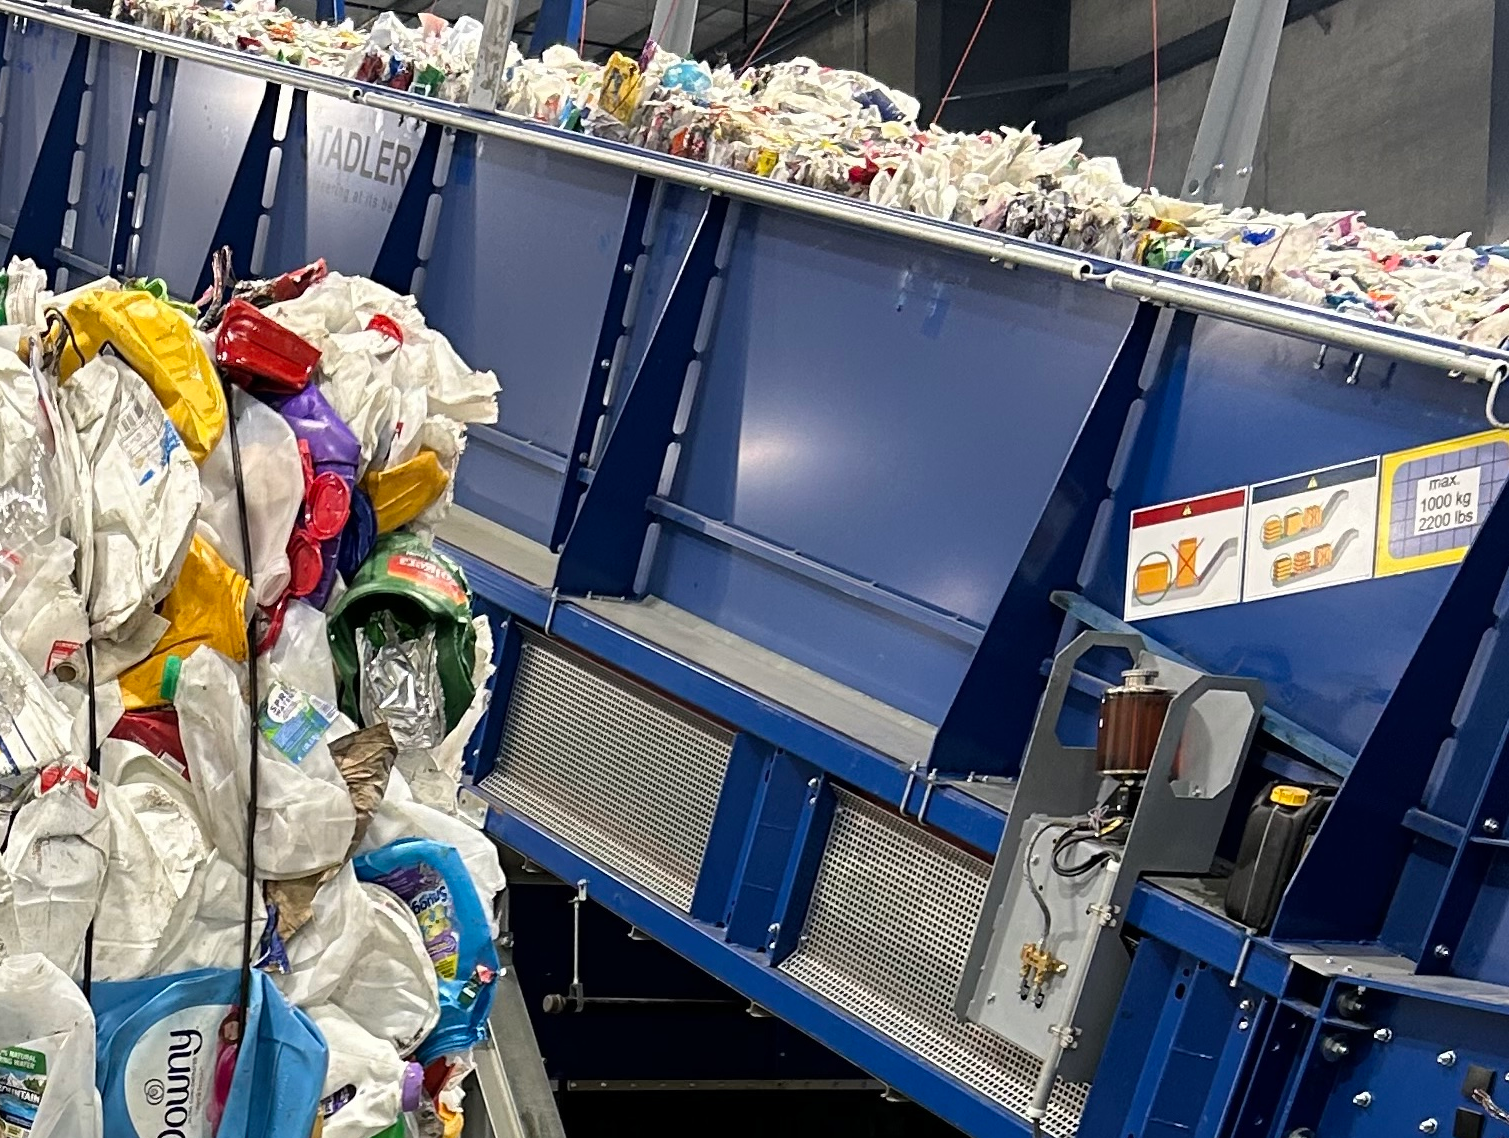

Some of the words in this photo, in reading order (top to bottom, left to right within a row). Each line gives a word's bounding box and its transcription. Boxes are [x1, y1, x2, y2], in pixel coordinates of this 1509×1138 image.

[1428, 474, 1460, 491] max.
[1421, 493, 1452, 512] 1000
[1455, 491, 1472, 507] kg
[1418, 512, 1451, 532] 2200
[1454, 509, 1474, 524] lbs
